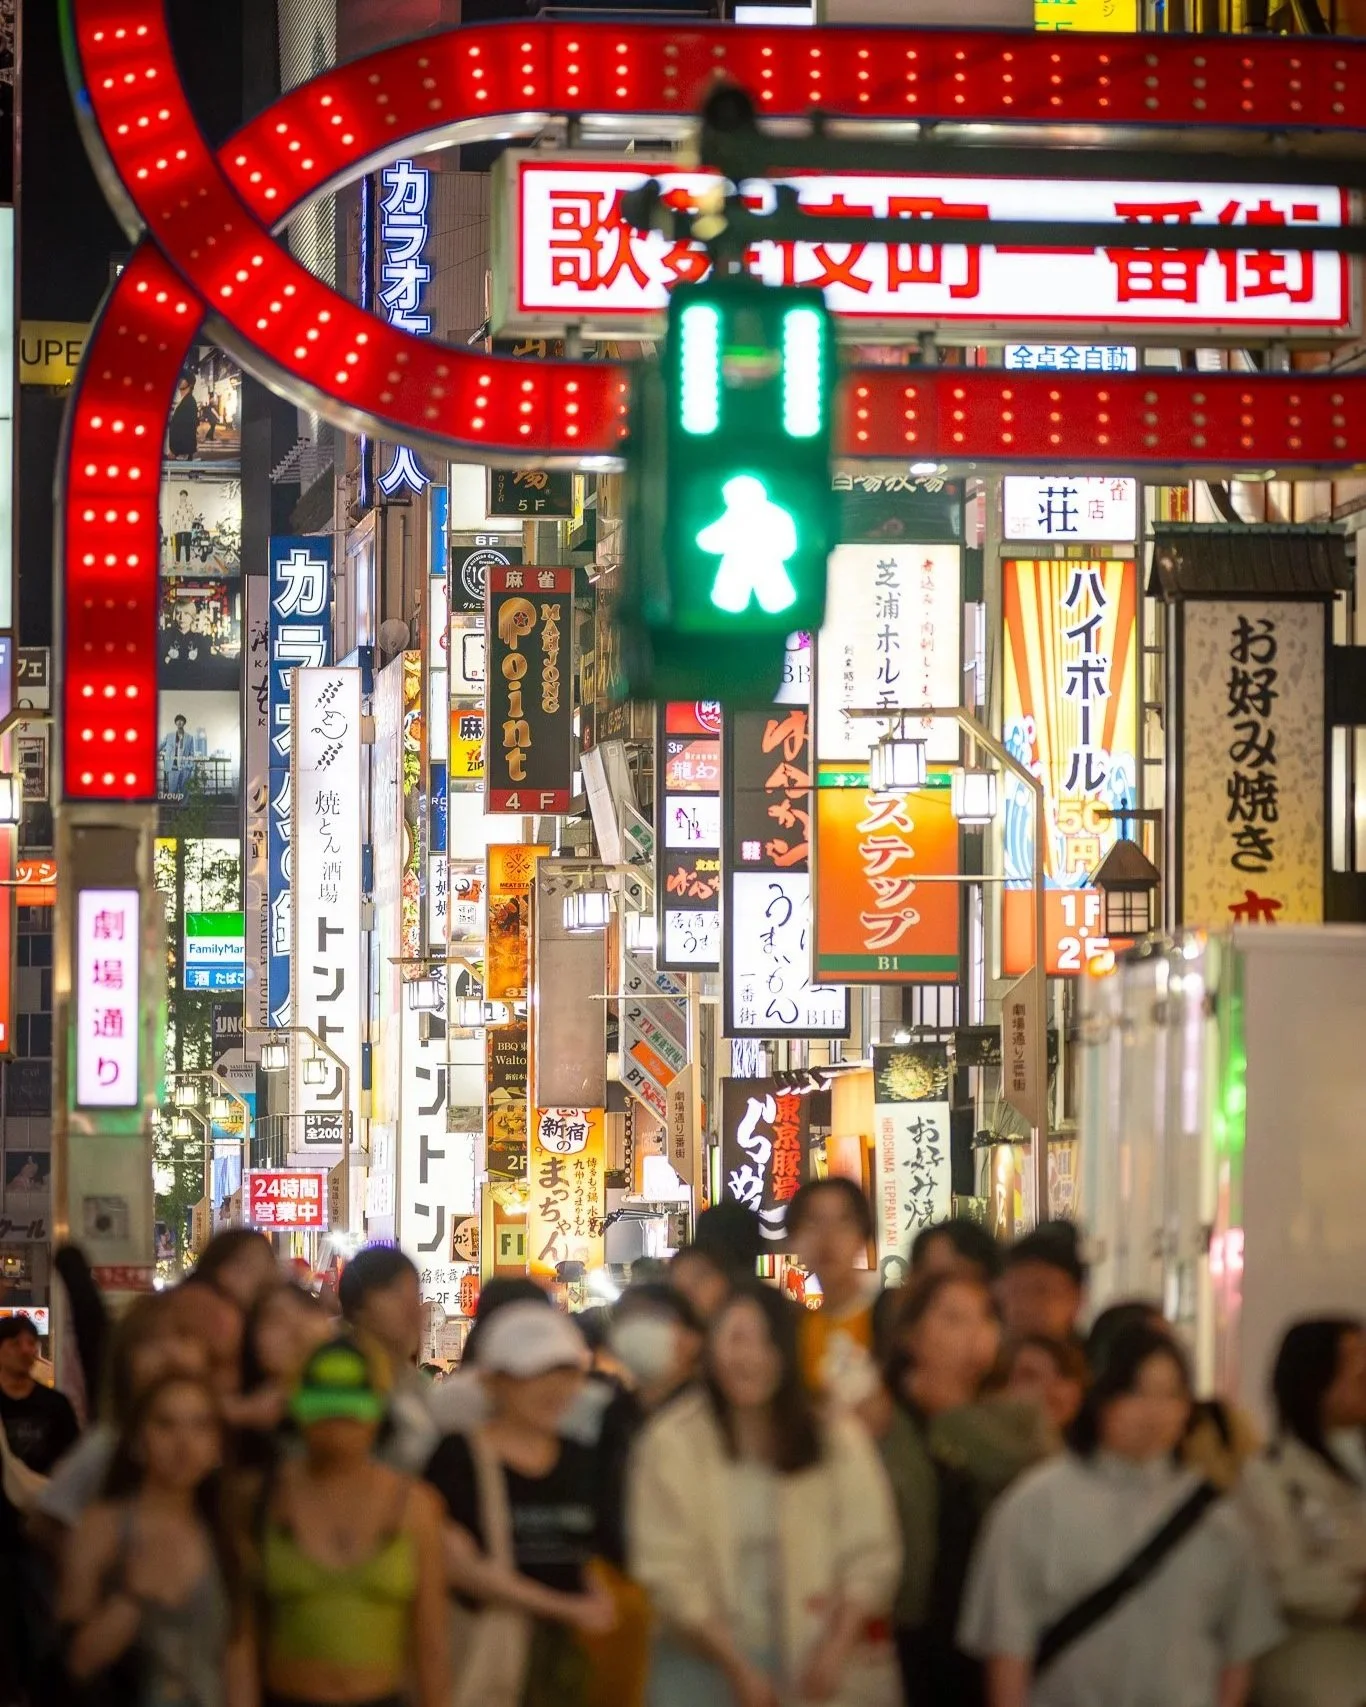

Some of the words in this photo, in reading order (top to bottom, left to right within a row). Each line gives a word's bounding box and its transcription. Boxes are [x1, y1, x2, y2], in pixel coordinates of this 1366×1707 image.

[1013, 346, 1128, 371] 全卓全自動
[518, 499, 546, 511] 5F
[1038, 486, 1079, 534] 荘
[475, 535, 499, 546] 6F
[505, 571, 555, 589] 麻雀
[1065, 572, 1108, 792] ハイボール
[1227, 616, 1279, 874] お好み焼き
[505, 792, 555, 809] 4F
[856, 793, 920, 950] ステップ
[878, 956, 899, 971] B1
[629, 976, 642, 990] 3
[93, 908, 125, 1087] 劇場通り
[312, 916, 344, 1101] トントン
[628, 1008, 642, 1022] 2
[497, 1042, 518, 1051] BBQ
[626, 1069, 645, 1088] B1
[306, 1127, 351, 1140] 全200
[541, 1116, 586, 1142] 新宿
[414, 1038, 446, 1253] ントン
[556, 1140, 571, 1152] の
[255, 1178, 318, 1199] 24時間
[254, 1201, 318, 1223] 営業中
[538, 1156, 572, 1261] まっちゃん
